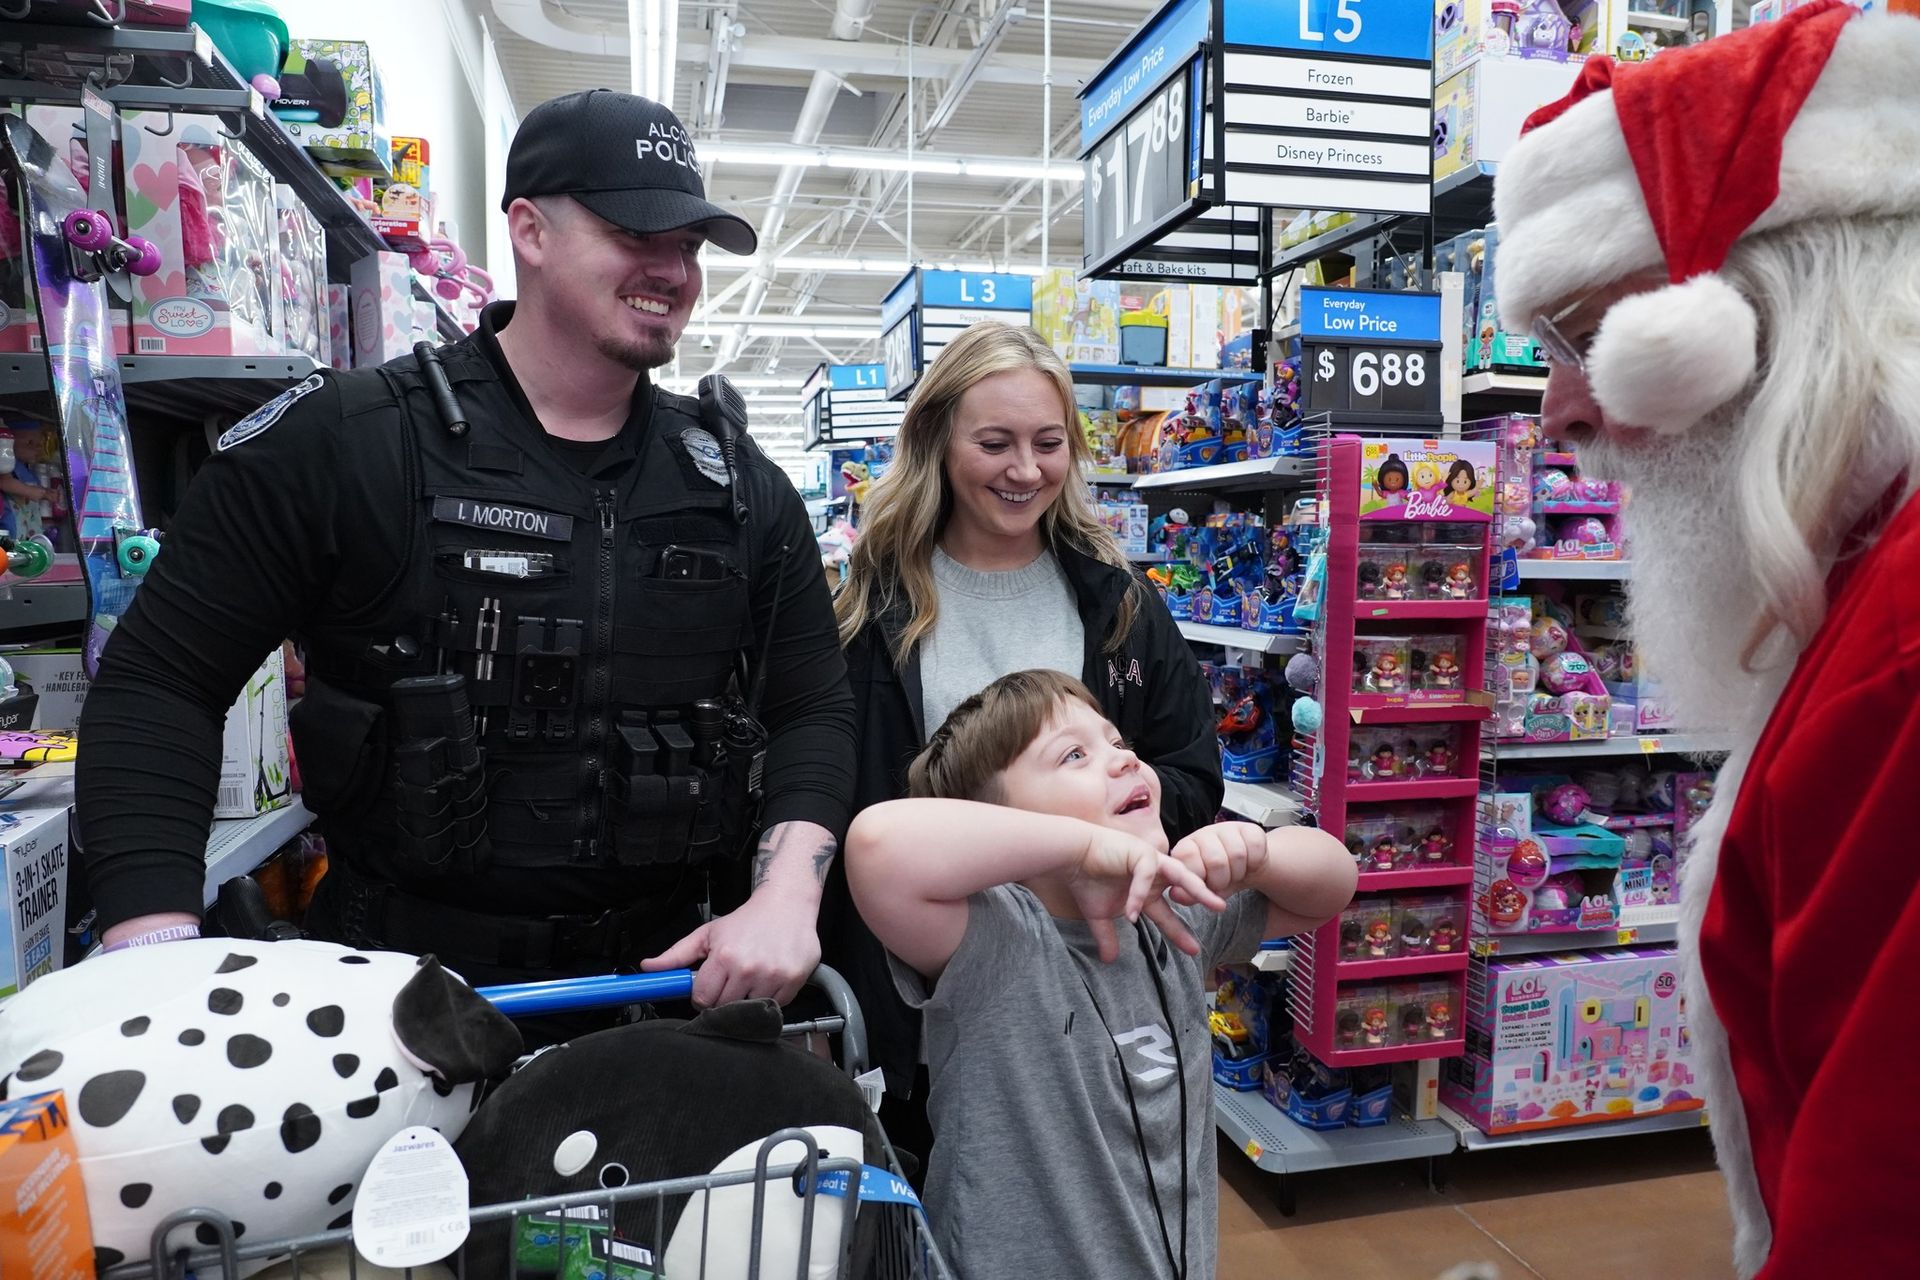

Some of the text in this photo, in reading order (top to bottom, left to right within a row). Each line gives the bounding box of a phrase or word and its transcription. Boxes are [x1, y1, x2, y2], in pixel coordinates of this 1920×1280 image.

[1299, 0, 1362, 43] L 5
[1088, 46, 1165, 128] Everyday Low Price
[1308, 69, 1353, 86] Frozen
[648, 122, 692, 147] ALCO
[1277, 144, 1383, 165] Disney Princess
[1146, 263, 1154, 273] &
[1158, 263, 1184, 274] Bake
[1187, 264, 1207, 275] kits
[960, 278, 996, 303] L 3
[158, 307, 209, 324] Sweet
[1323, 298, 1365, 312] Everyday
[1324, 313, 1398, 332] Low Price
[1403, 491, 1454, 519] Barbie
[458, 503, 548, 533] I. MORTON
[59, 671, 75, 681] KEY
[15, 843, 65, 897] 3-IN-1 SKATE
[18, 877, 58, 931] TRAINER
[32, 939, 50, 965] EASY
[1658, 975, 1673, 987] 50
